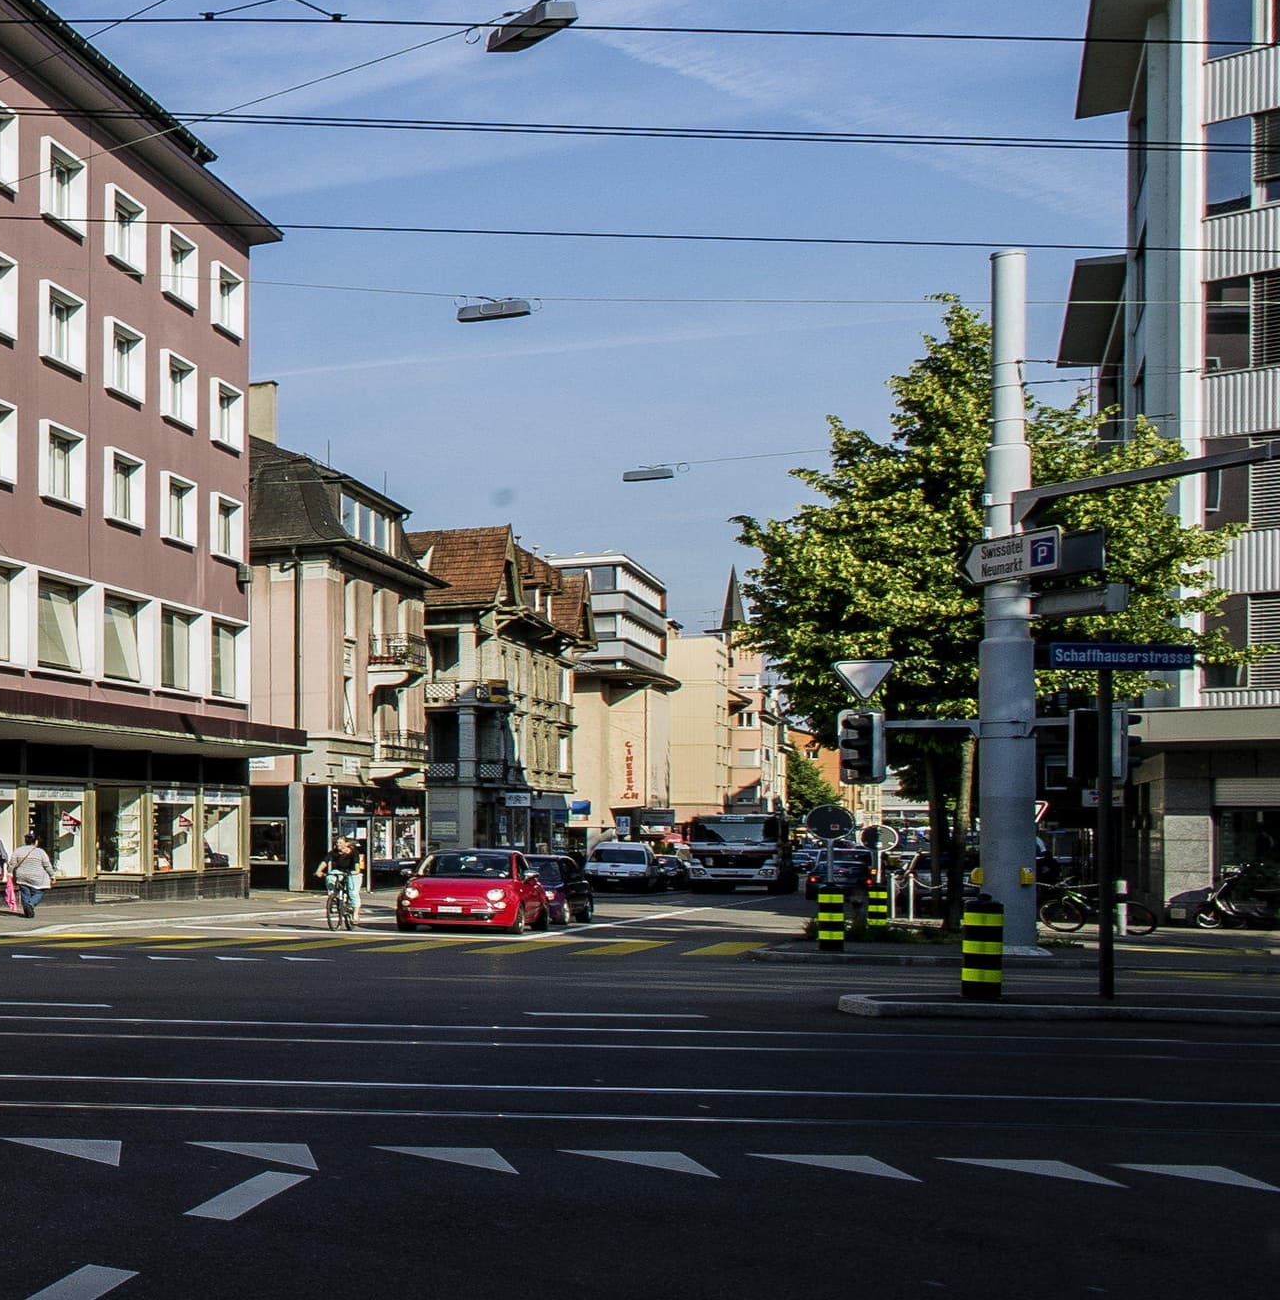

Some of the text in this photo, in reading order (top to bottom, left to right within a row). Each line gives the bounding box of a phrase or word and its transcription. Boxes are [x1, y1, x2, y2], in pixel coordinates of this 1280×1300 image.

[981, 538, 1024, 560] Swissôtel
[981, 558, 1023, 578] Neumarkt
[1055, 648, 1191, 664] Schaffhauserstrasse
